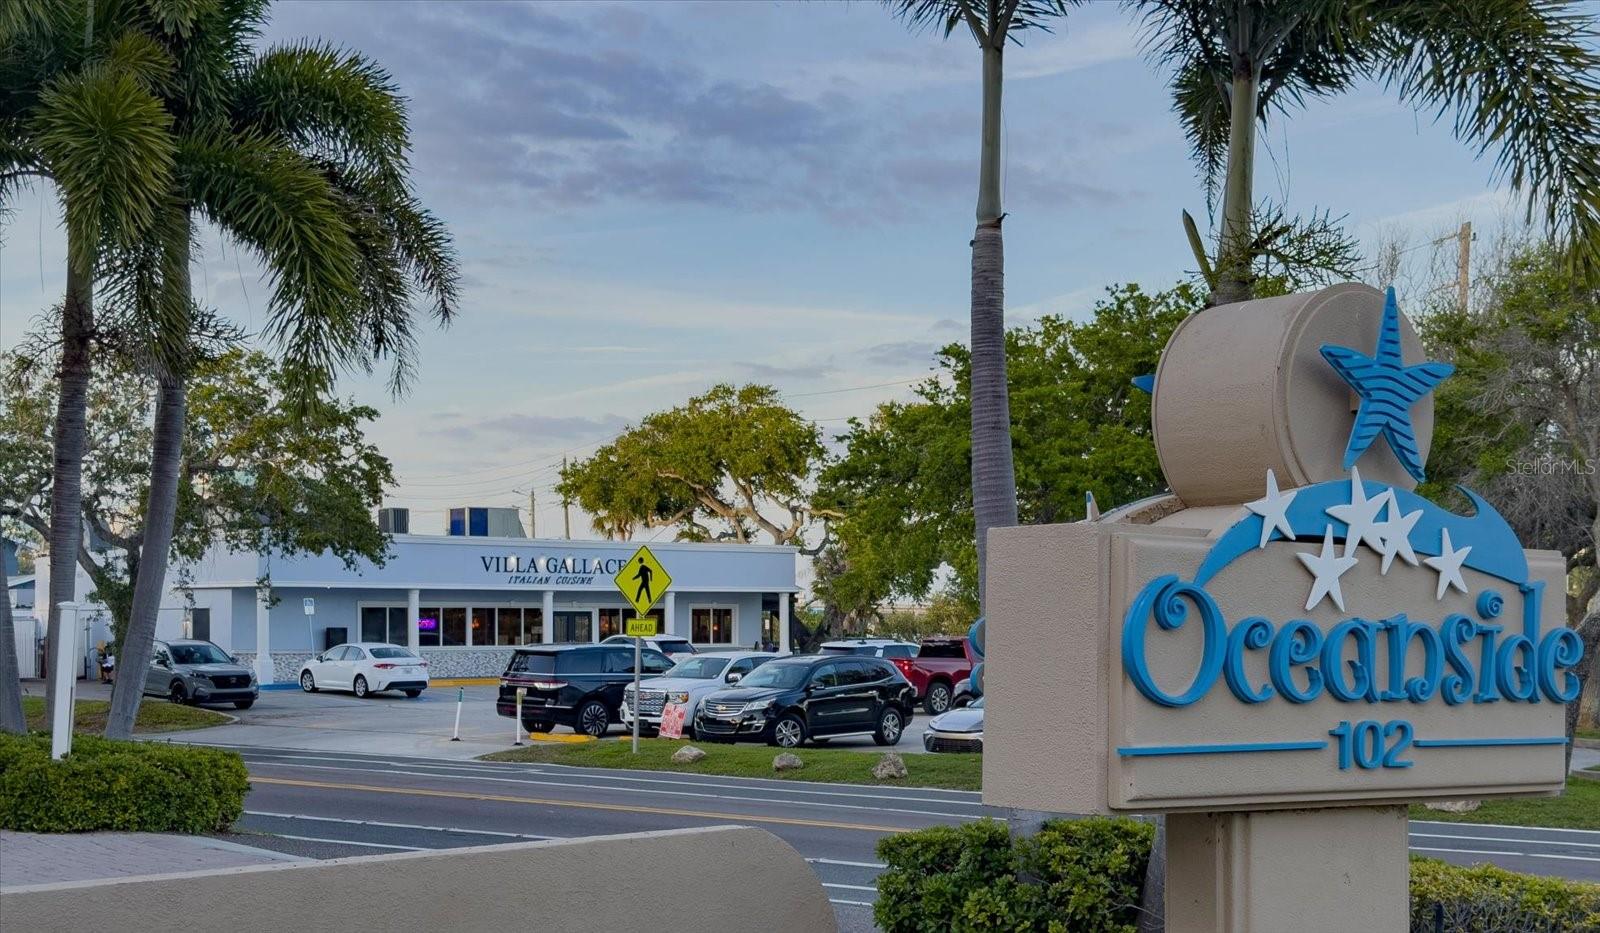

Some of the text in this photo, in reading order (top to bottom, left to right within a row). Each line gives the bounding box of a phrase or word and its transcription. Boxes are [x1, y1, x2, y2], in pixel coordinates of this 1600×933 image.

[481, 556, 539, 573] VILLA
[508, 575, 594, 585] ITALIAN CUISINE
[630, 623, 653, 633] AHEAD
[1122, 575, 1584, 708] Oceanside
[1328, 720, 1414, 770] 102
